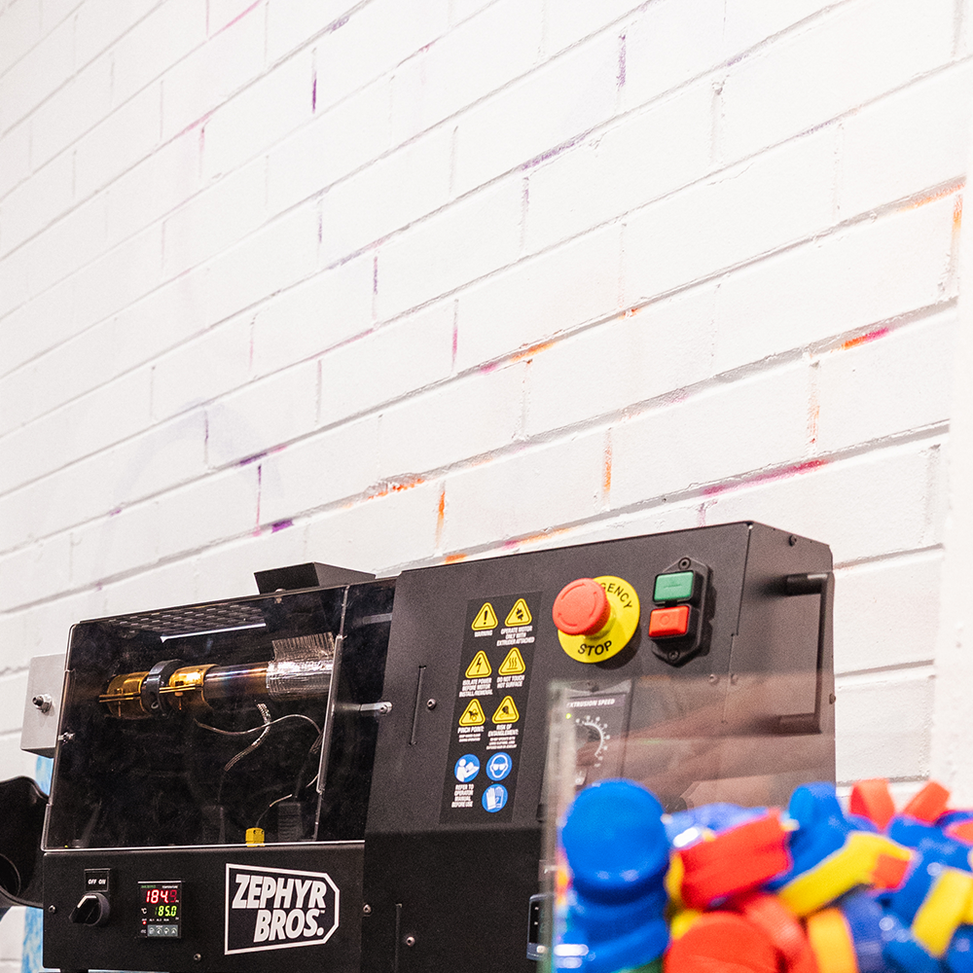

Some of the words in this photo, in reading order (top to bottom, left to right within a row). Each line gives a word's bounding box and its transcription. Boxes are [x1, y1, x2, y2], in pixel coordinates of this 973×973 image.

[601, 582, 633, 609] GENCY
[578, 640, 612, 656] STOP
[598, 698, 615, 706] SPEED
[232, 873, 327, 909] ZEPHYR
[253, 909, 325, 943] BROS.
